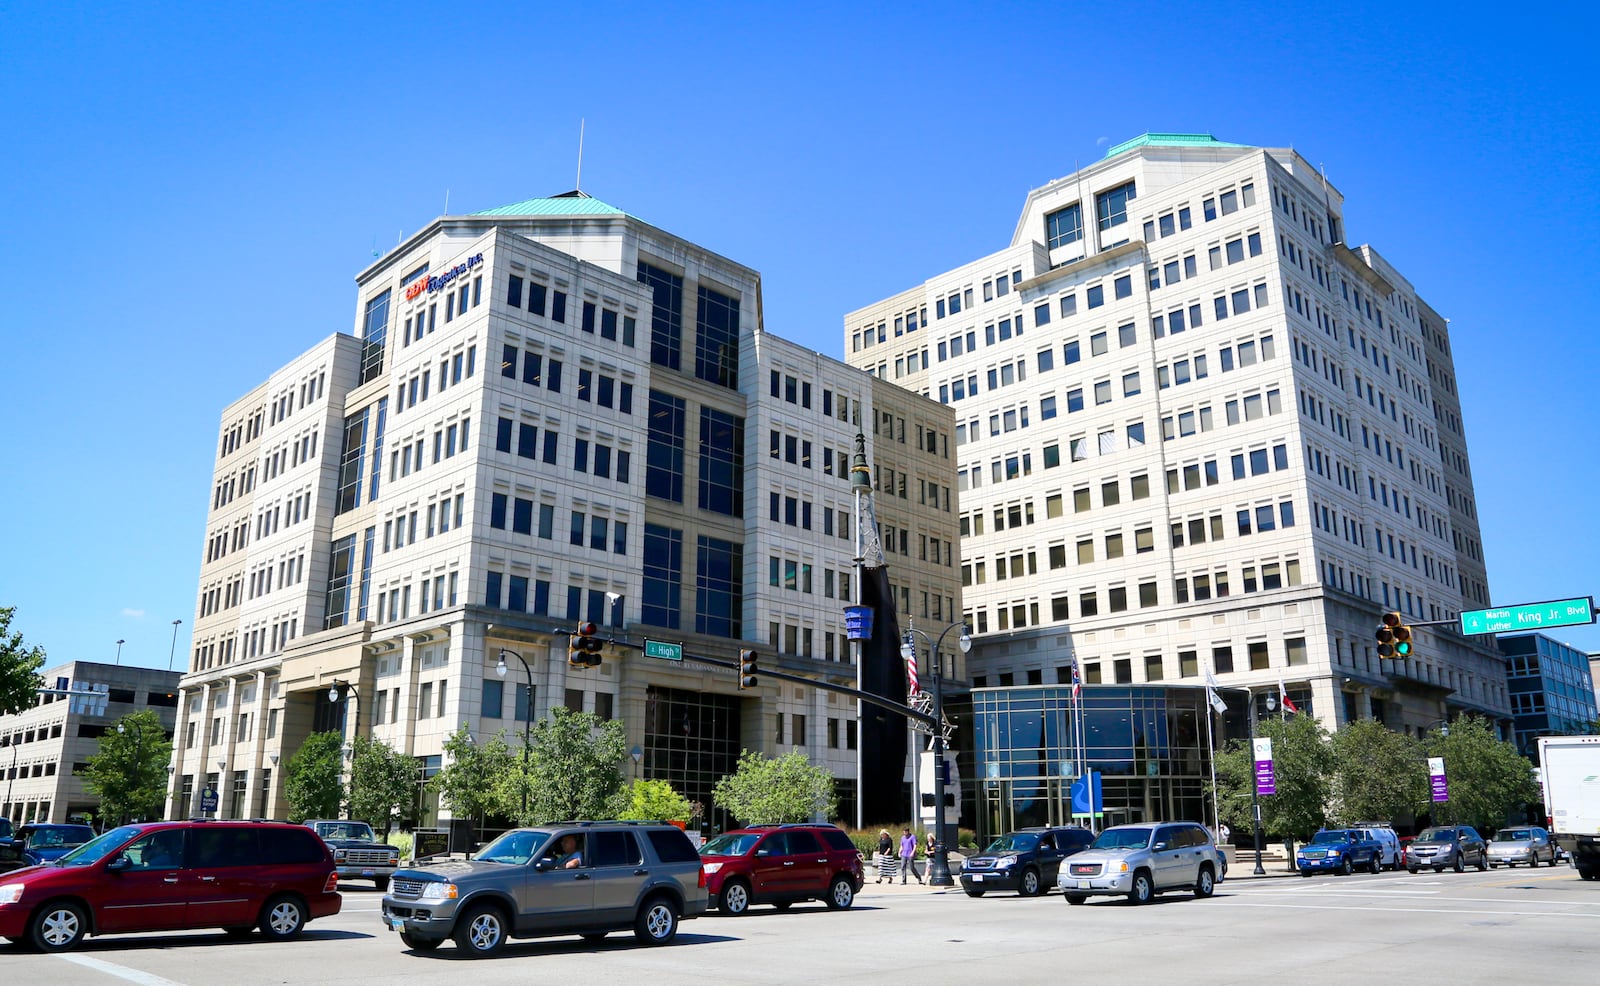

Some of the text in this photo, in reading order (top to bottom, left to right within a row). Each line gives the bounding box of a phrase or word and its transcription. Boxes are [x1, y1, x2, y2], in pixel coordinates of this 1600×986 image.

[1486, 610, 1510, 619] Martin
[1486, 606, 1586, 631] Luther King Jr. Blvd
[658, 646, 674, 657] High
